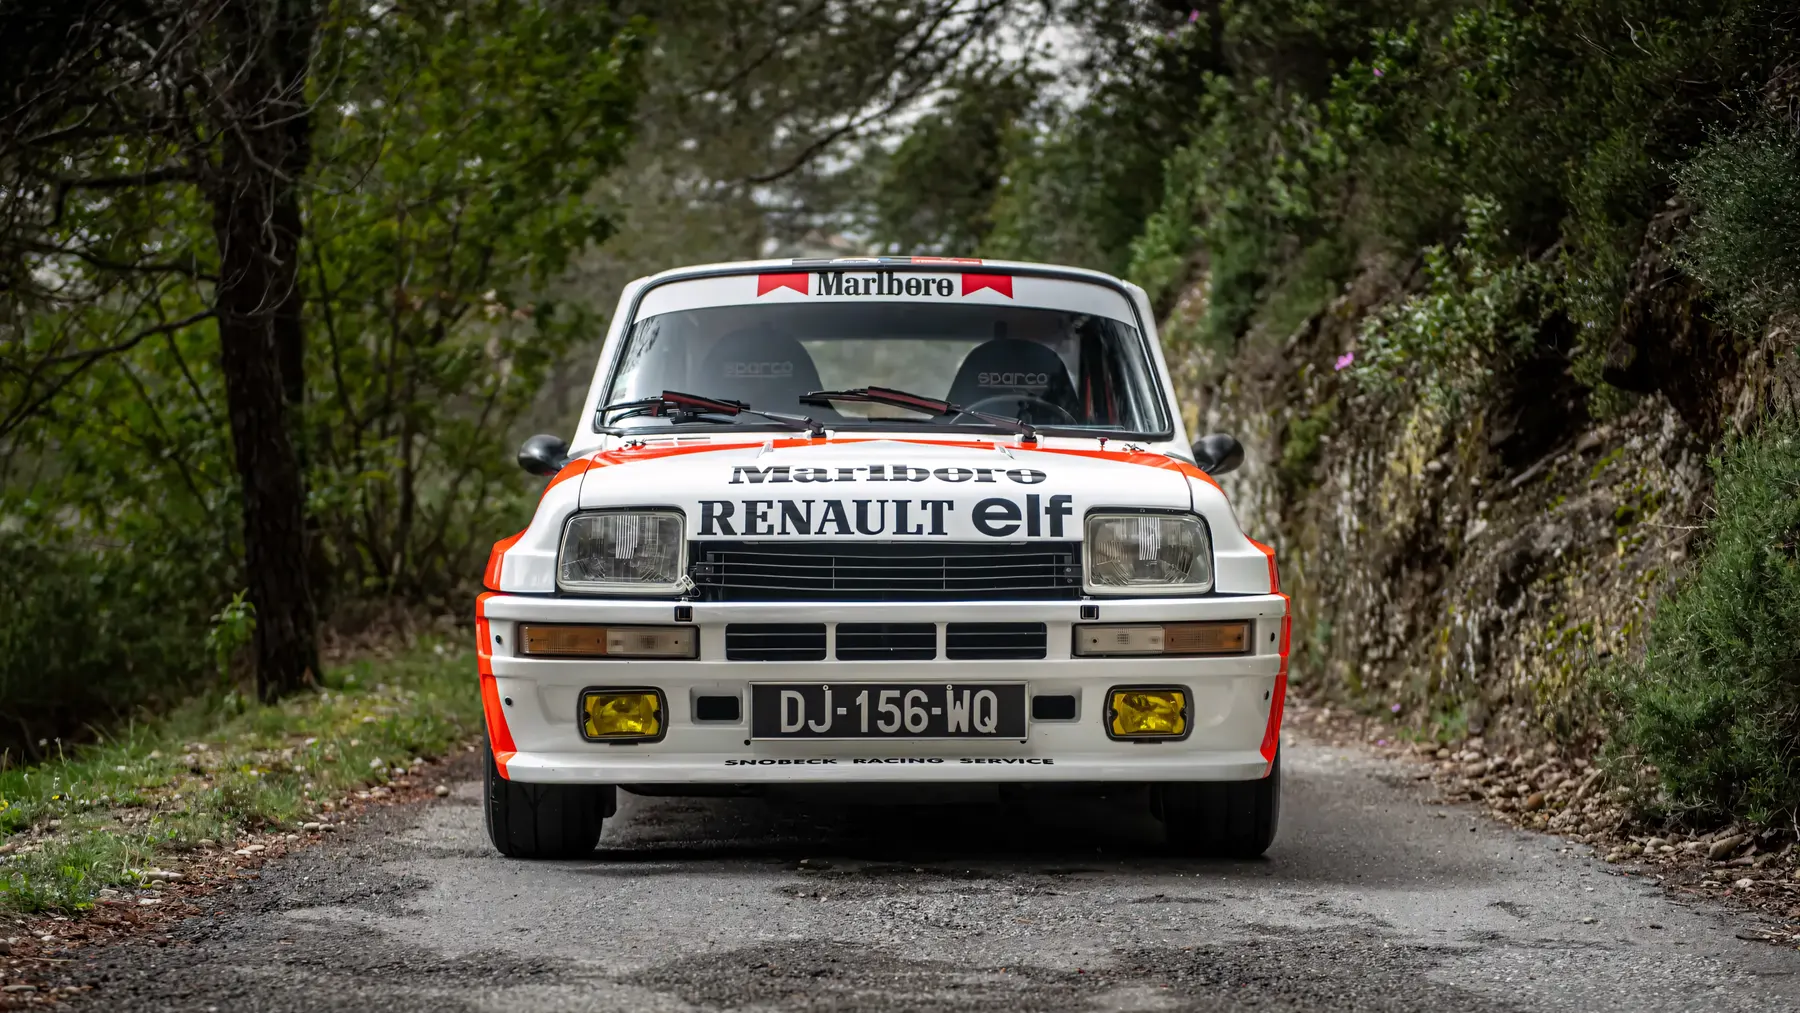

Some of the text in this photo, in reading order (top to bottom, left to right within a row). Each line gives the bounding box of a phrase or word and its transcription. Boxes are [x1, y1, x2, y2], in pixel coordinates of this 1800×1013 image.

[816, 272, 954, 297] Marlboro
[978, 371, 1048, 387] sparco
[728, 465, 1047, 484] Marlboro
[697, 494, 1072, 537] RENAULT elf
[780, 689, 997, 734] DJ-156-WQ
[724, 758, 838, 766] SNOBECK
[959, 757, 1055, 765] SERVICE
